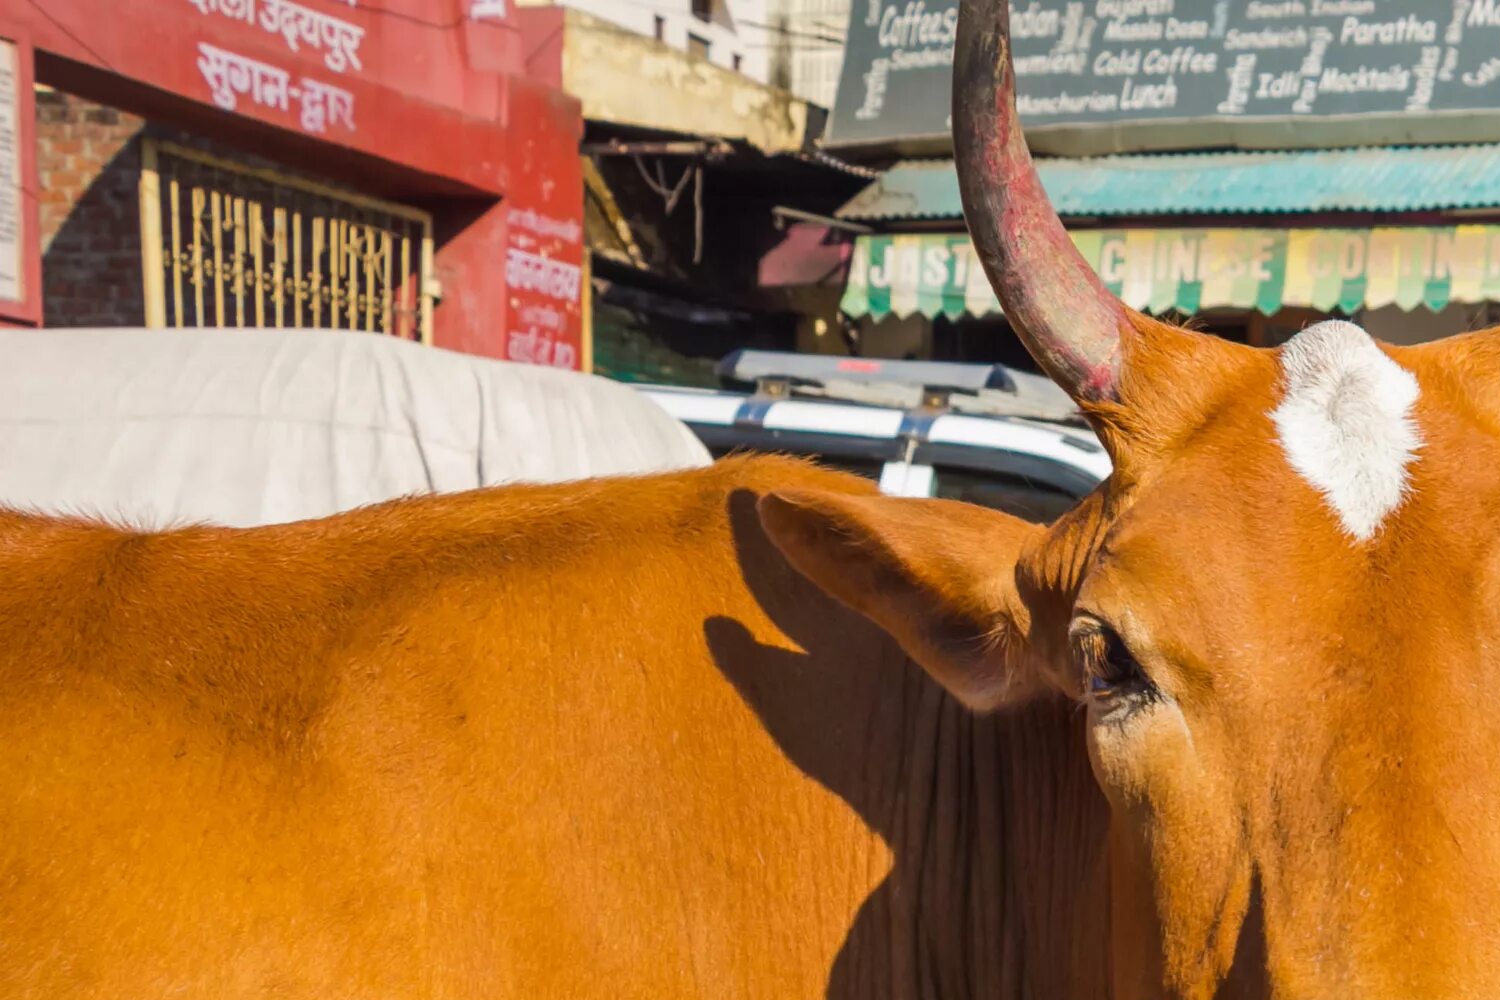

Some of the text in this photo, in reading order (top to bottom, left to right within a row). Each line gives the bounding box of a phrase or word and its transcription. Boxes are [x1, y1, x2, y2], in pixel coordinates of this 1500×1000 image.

[1340, 14, 1437, 47] Paratha
[1093, 46, 1218, 76] Cold Coffee
[1120, 76, 1177, 111] Lunch
[1255, 71, 1300, 98] Idli
[1318, 65, 1411, 92] Mocktails
